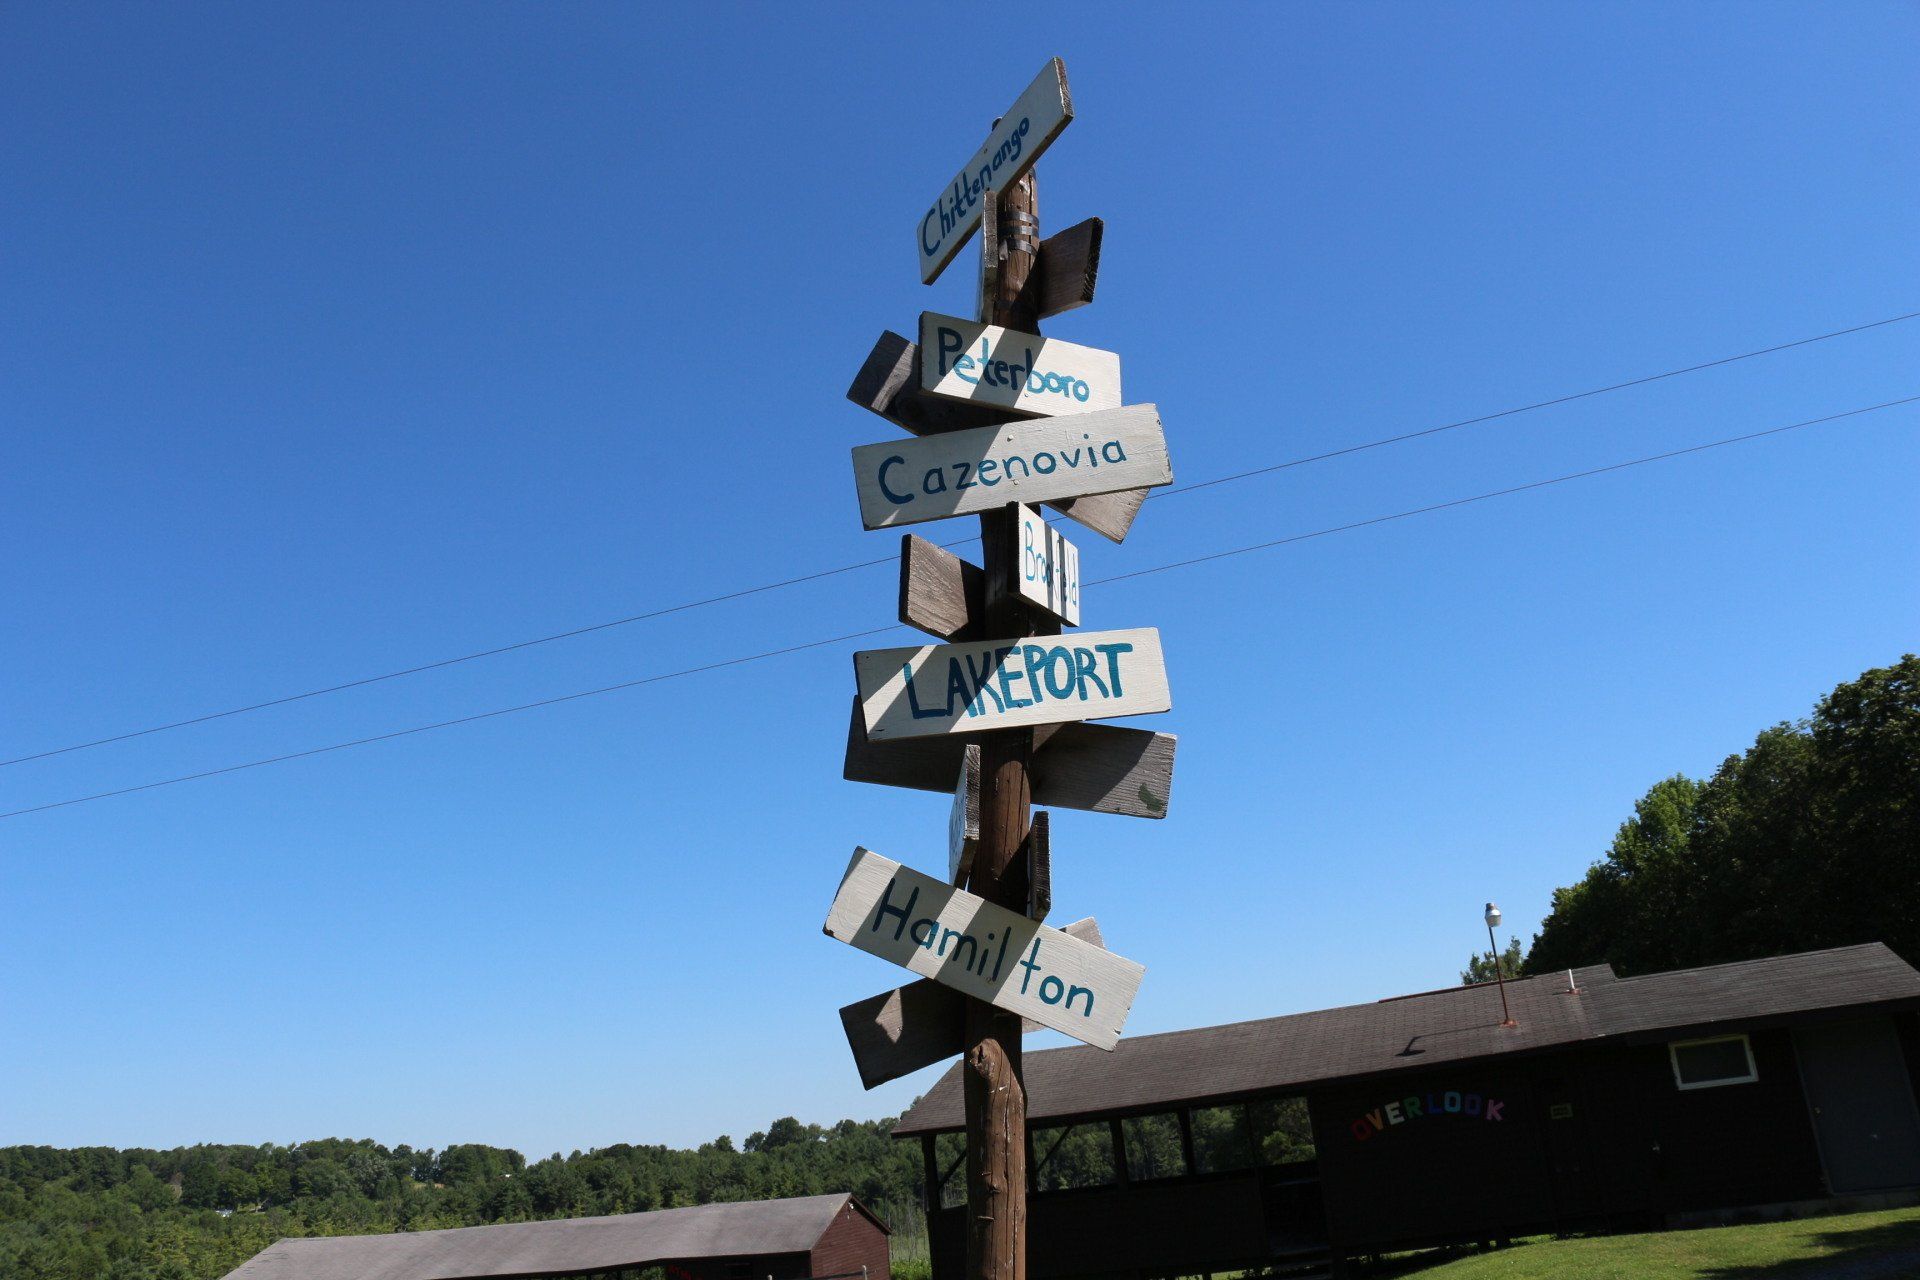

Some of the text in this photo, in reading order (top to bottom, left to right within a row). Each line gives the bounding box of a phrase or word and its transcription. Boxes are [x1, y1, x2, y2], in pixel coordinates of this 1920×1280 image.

[921, 116, 1030, 257] Chittenango
[937, 326, 1090, 402] Peterboro
[877, 433, 1128, 505] Cazenovia
[1024, 520, 1078, 608] Brookfield
[902, 642, 1134, 719] LAKEPORT
[871, 877, 1096, 1018] Hamilton
[1350, 1091, 1506, 1142] OVERLOOK
